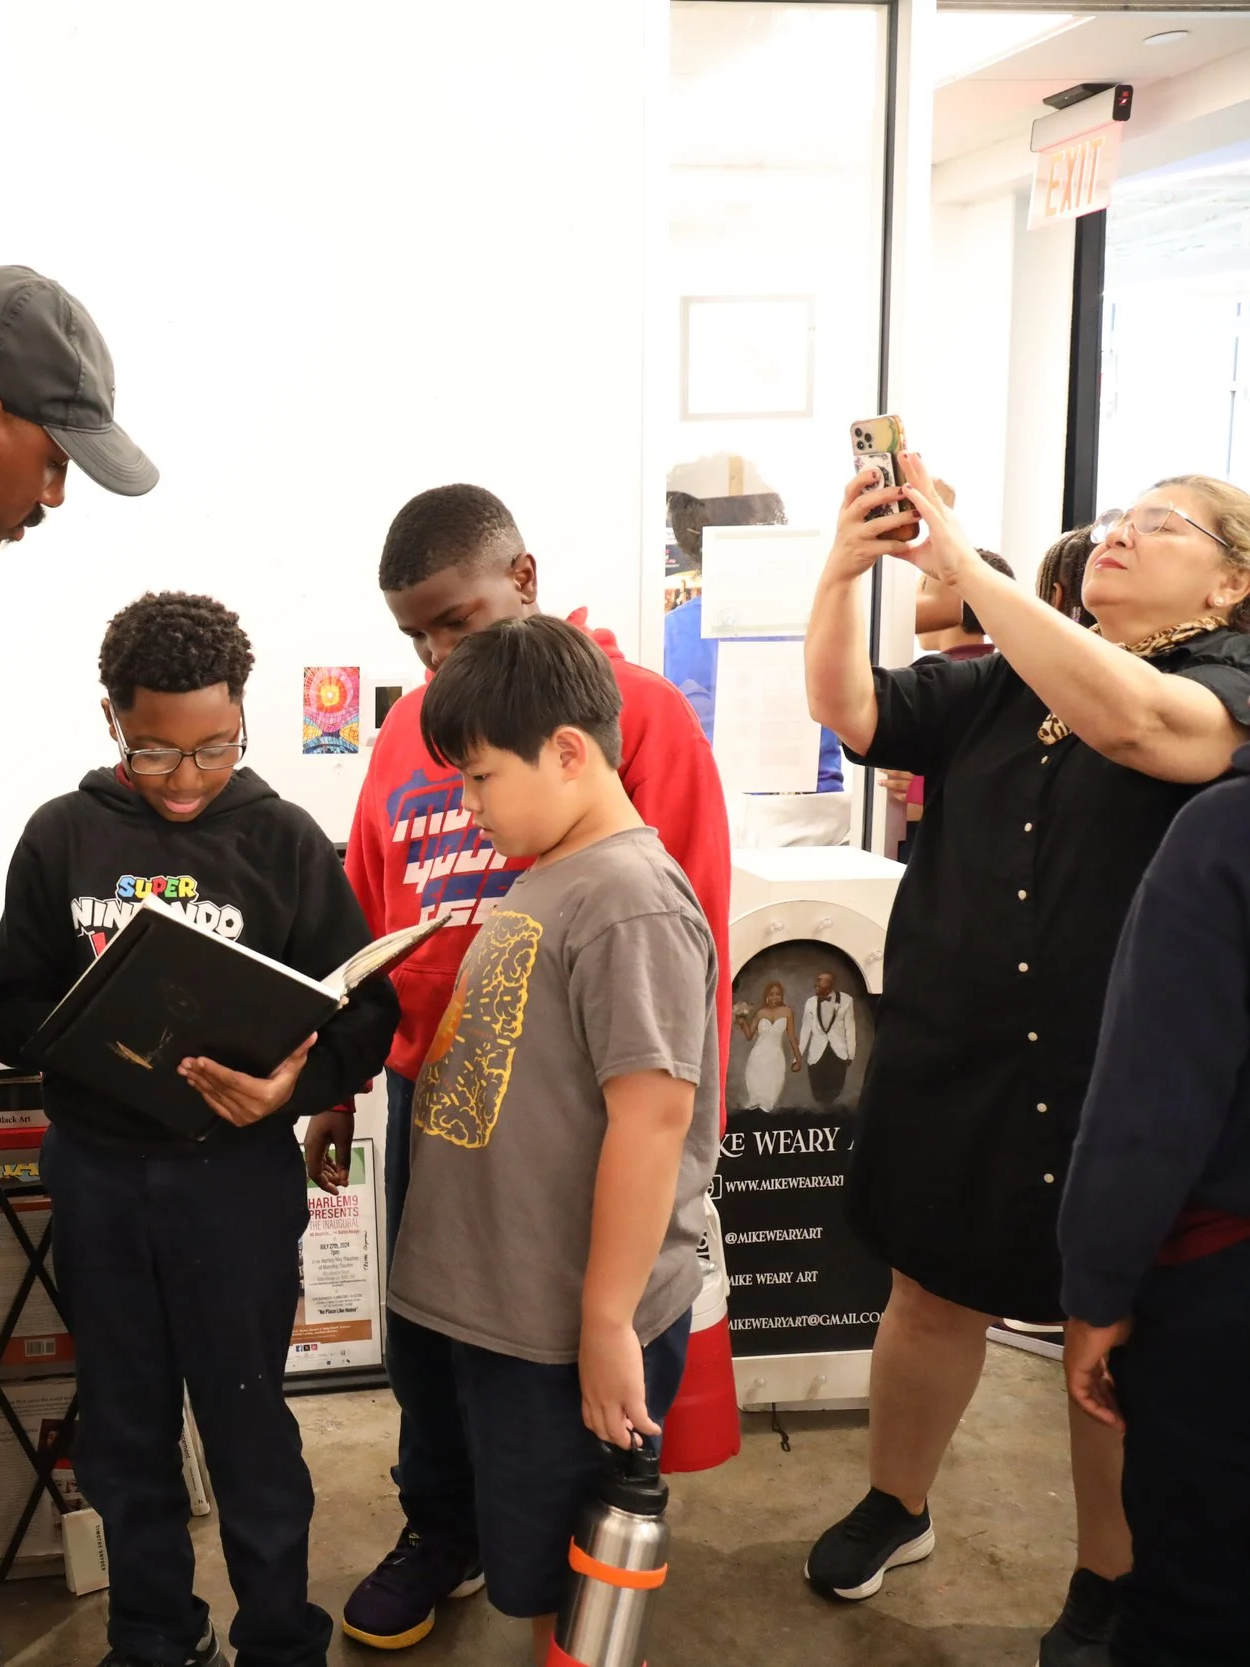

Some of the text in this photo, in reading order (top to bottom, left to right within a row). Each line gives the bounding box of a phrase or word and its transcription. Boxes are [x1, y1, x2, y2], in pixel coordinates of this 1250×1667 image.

[1045, 137, 1105, 217] EXIT
[117, 875, 198, 899] SUPER
[19, 1115, 31, 1123] Art
[753, 1127, 840, 1156] WEARY
[308, 1195, 358, 1209] HARLEM9
[308, 1207, 359, 1219] PRESENTS
[310, 1218, 359, 1231] THE INAUGURAL
[725, 1228, 823, 1244] @MIKEWEARYART
[756, 1272, 793, 1285] WEARY
[796, 1271, 819, 1283] ART
[728, 1312, 884, 1331] MIKEWEARYART@GMAIL.CO
